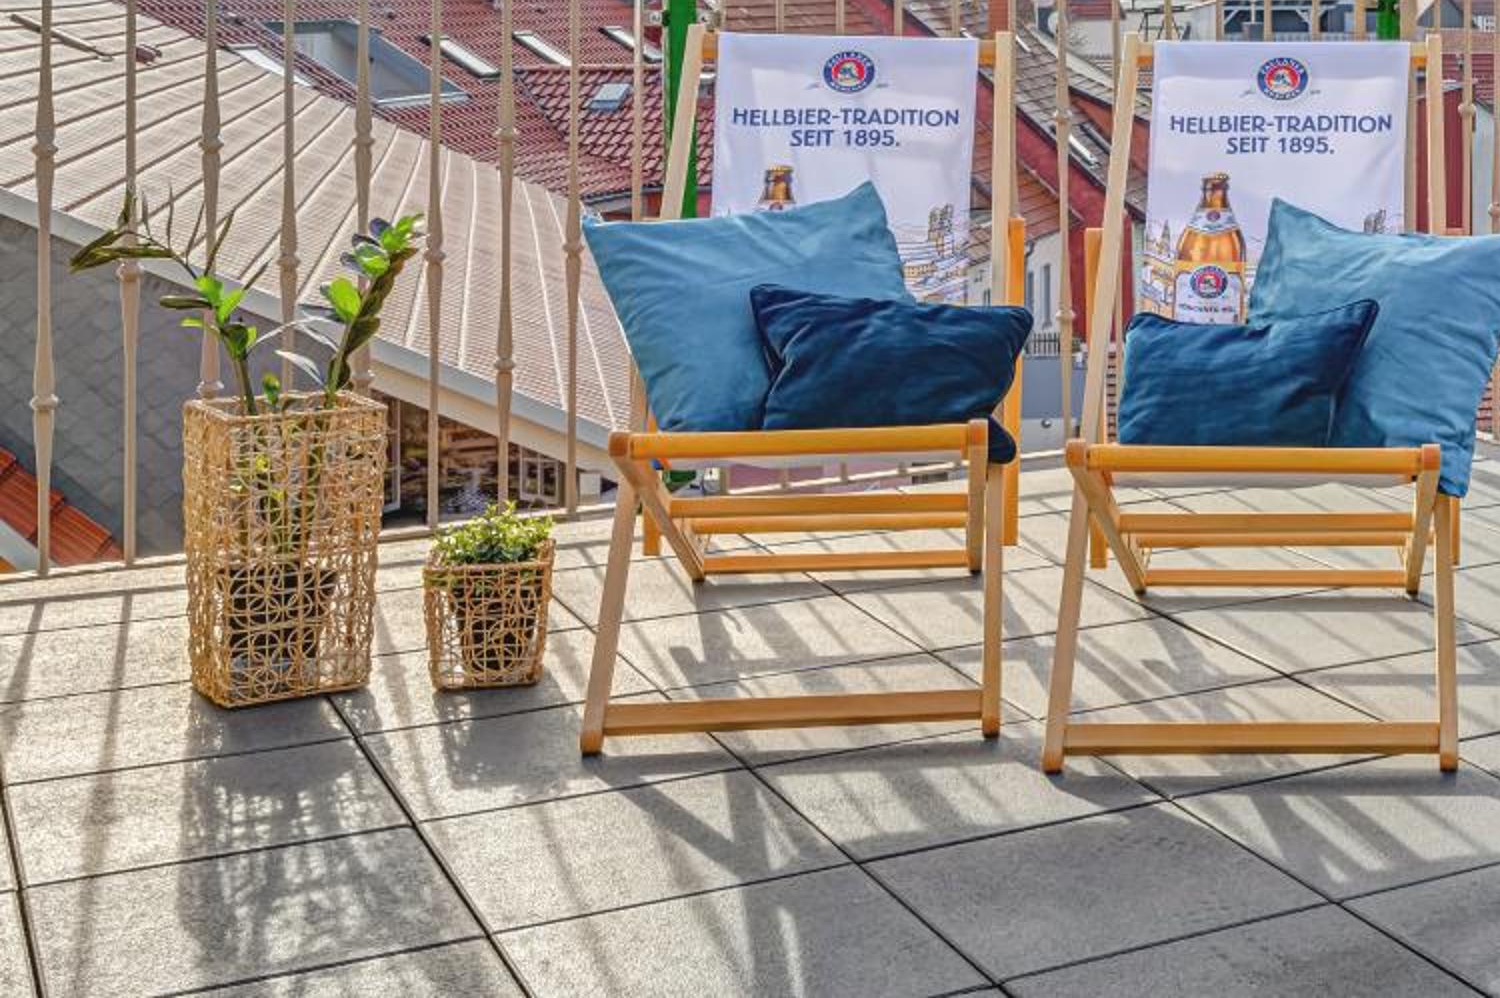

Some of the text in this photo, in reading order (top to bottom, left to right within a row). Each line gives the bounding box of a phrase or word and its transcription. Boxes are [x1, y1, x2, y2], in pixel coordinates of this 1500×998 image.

[732, 107, 960, 127] HELLBIER-TRADITION
[1170, 114, 1393, 134] HELLBIER-TRADITION
[790, 129, 900, 147] SEIT 1895.
[1226, 136, 1335, 154] SEIT 1895.
